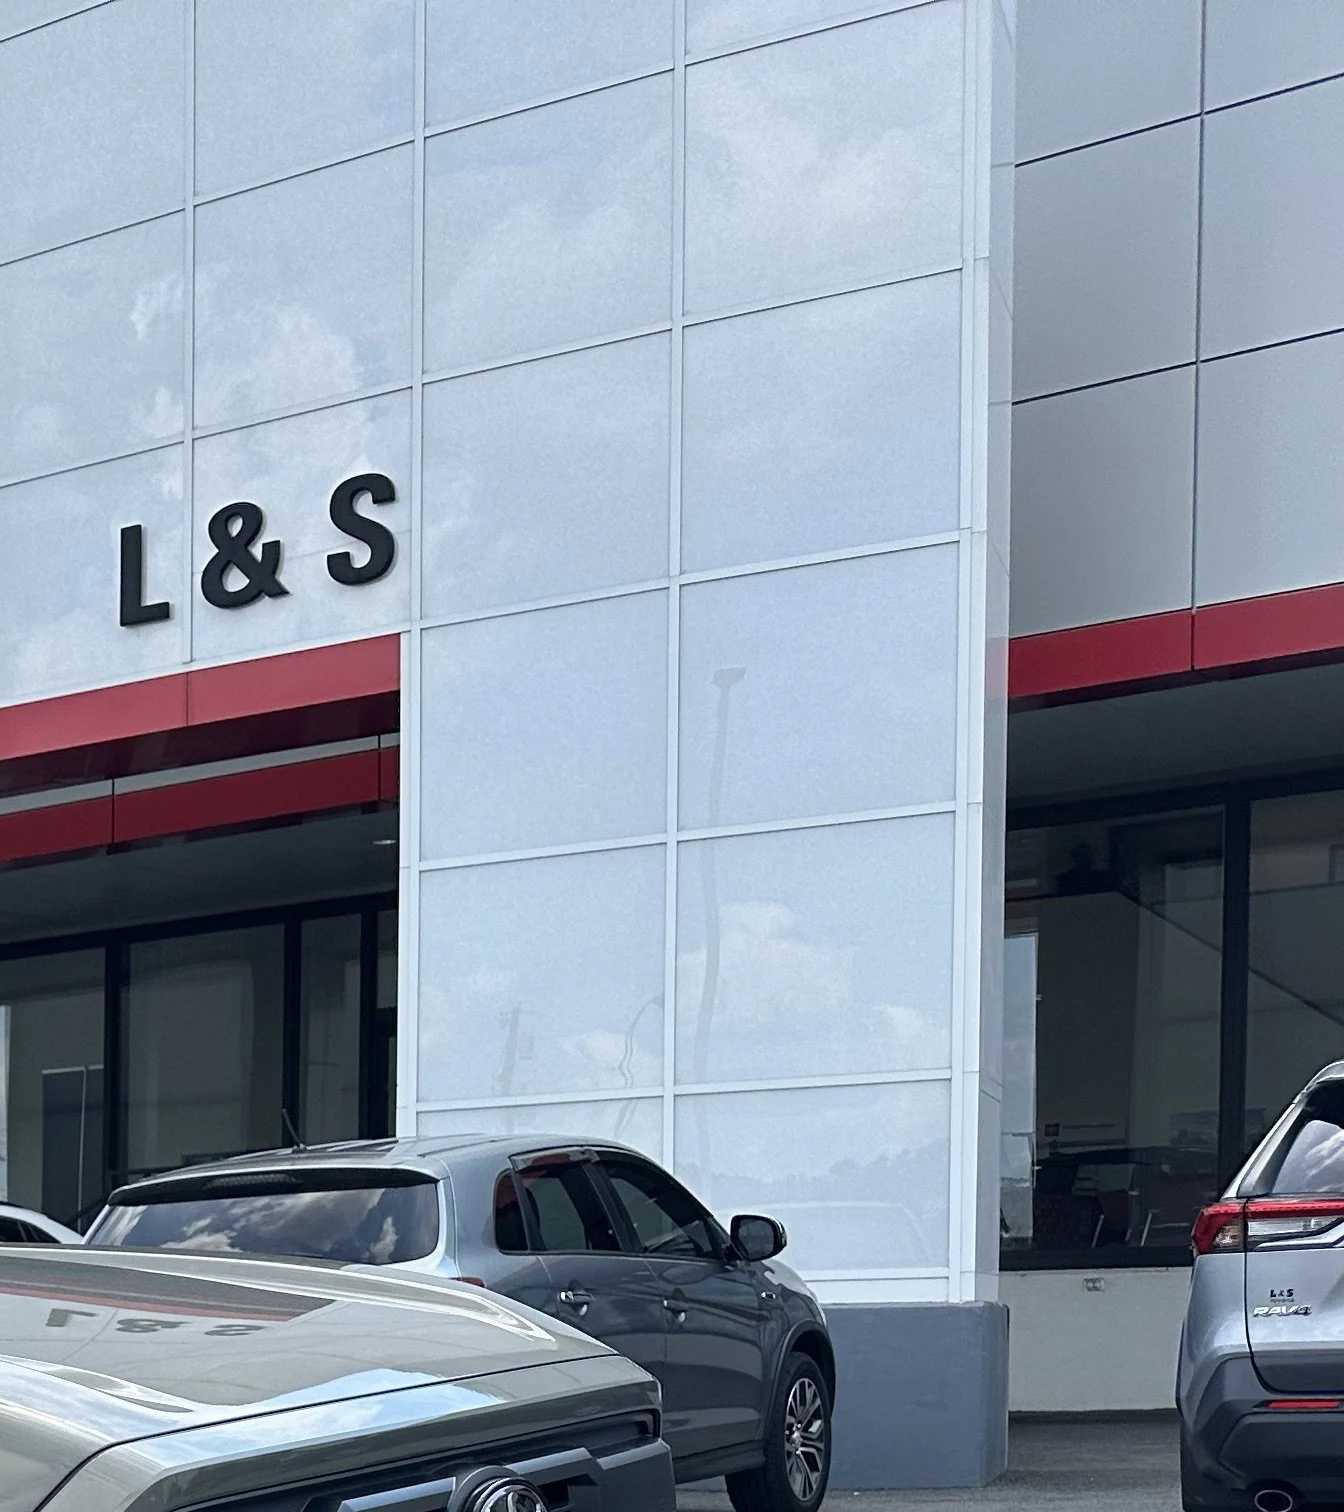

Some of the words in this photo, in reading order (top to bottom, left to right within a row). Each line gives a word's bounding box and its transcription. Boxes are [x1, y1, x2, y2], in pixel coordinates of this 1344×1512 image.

[120, 524, 170, 627] L
[201, 502, 289, 608] &
[327, 473, 396, 585] S
[1253, 1305, 1312, 1317] RAV4
